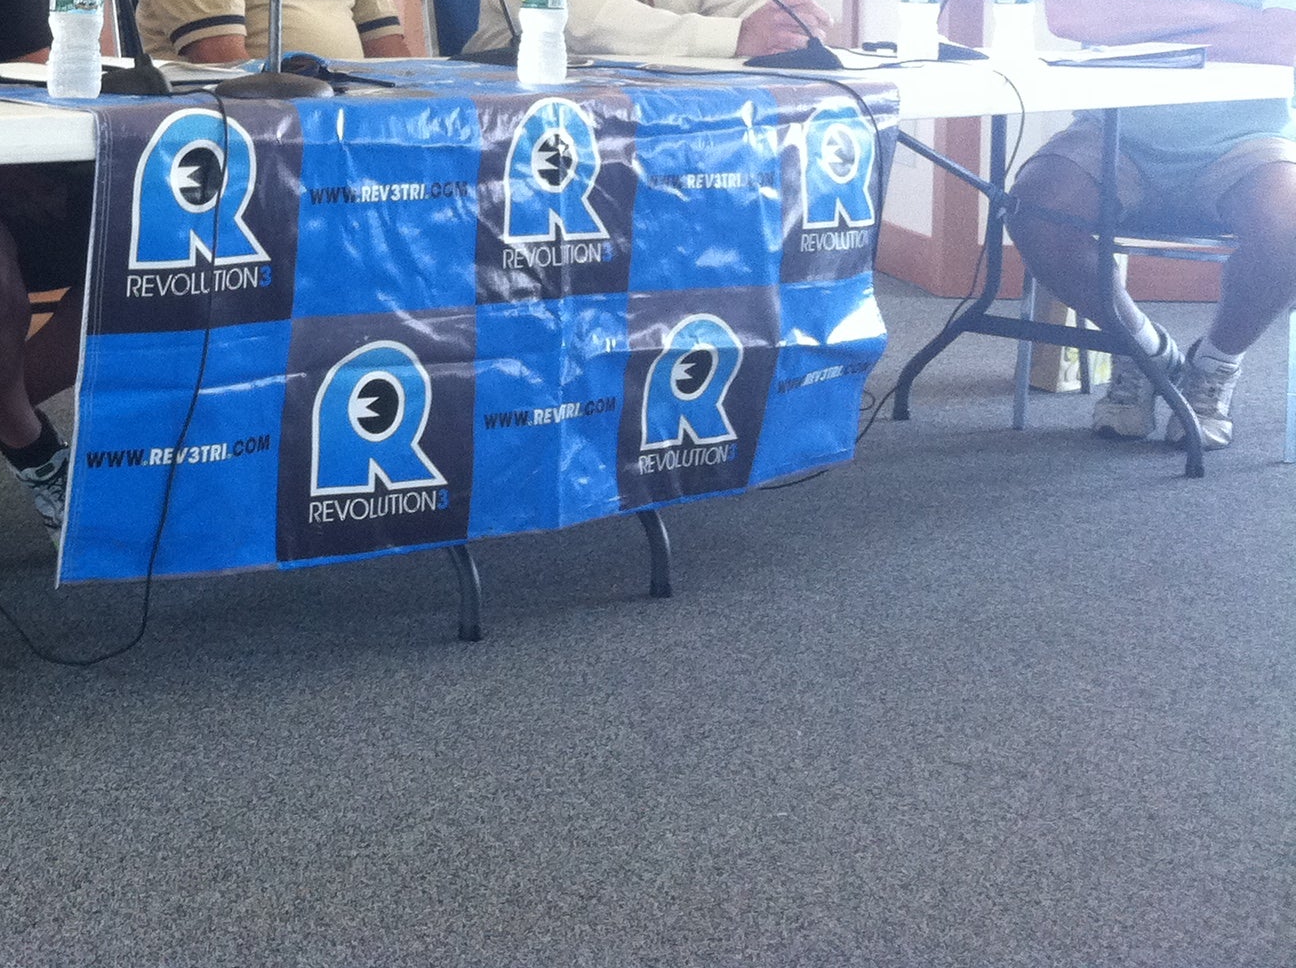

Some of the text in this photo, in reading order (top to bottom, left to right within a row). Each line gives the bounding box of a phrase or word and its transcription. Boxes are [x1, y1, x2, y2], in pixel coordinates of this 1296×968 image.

[502, 242, 613, 269] REVOLTION3
[484, 397, 616, 430] WWW.REVTRI.COM
[86, 434, 271, 468] WWW.REV3TRI.COM
[638, 443, 738, 475] REVOLUTION3
[309, 488, 450, 524] REVOLUTION3
